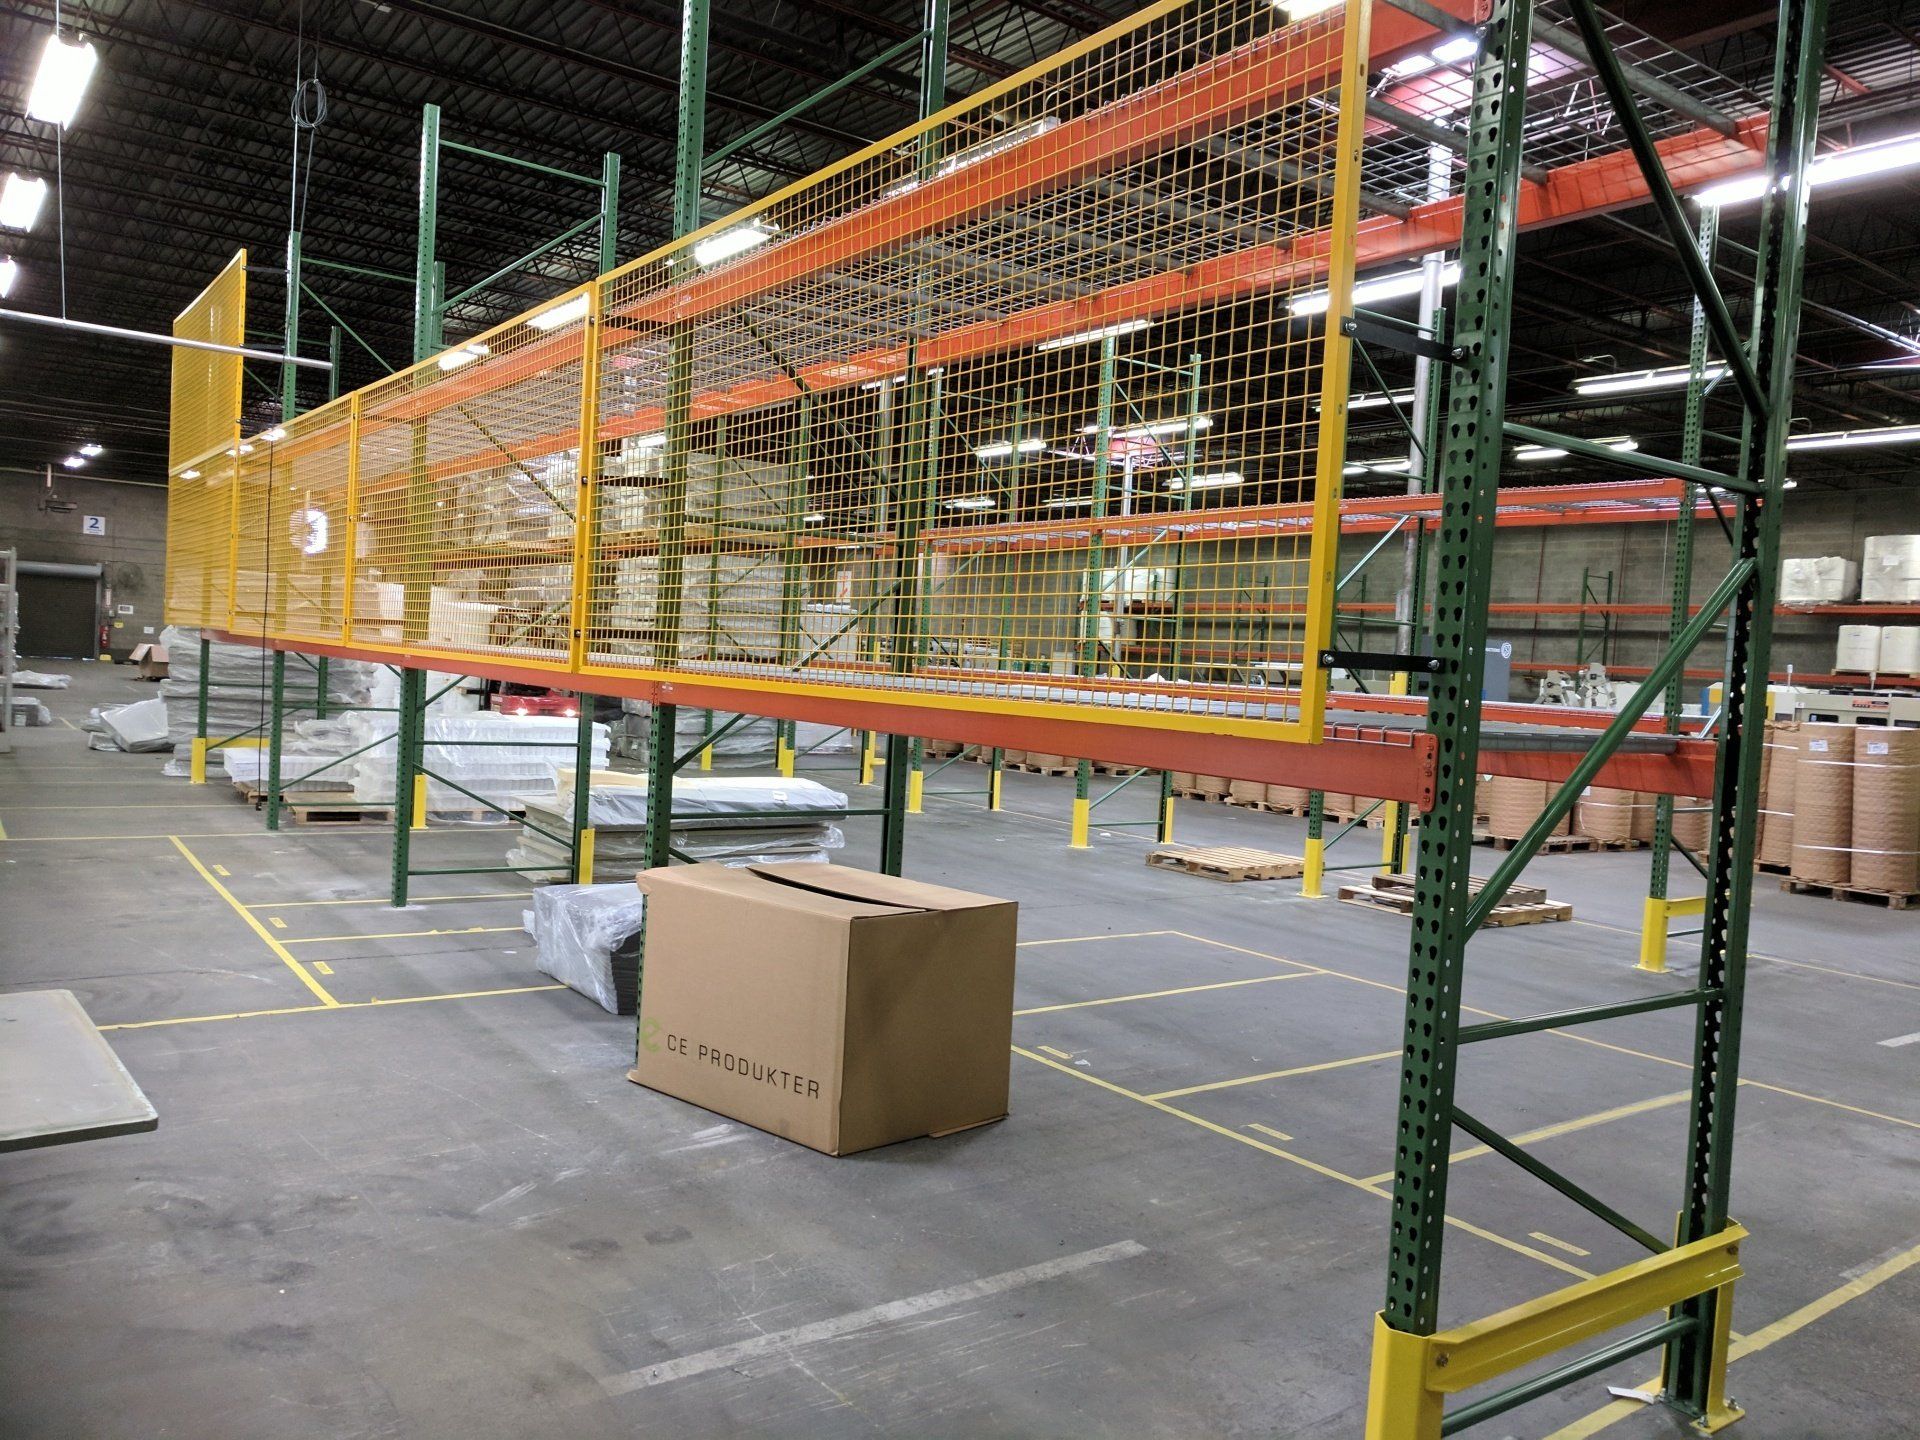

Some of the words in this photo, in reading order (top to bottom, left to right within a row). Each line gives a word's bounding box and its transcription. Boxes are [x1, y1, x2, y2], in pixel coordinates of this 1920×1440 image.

[90, 518, 99, 528] 2
[667, 1034, 688, 1056] CE
[698, 1044, 820, 1100] PRODUKTER
